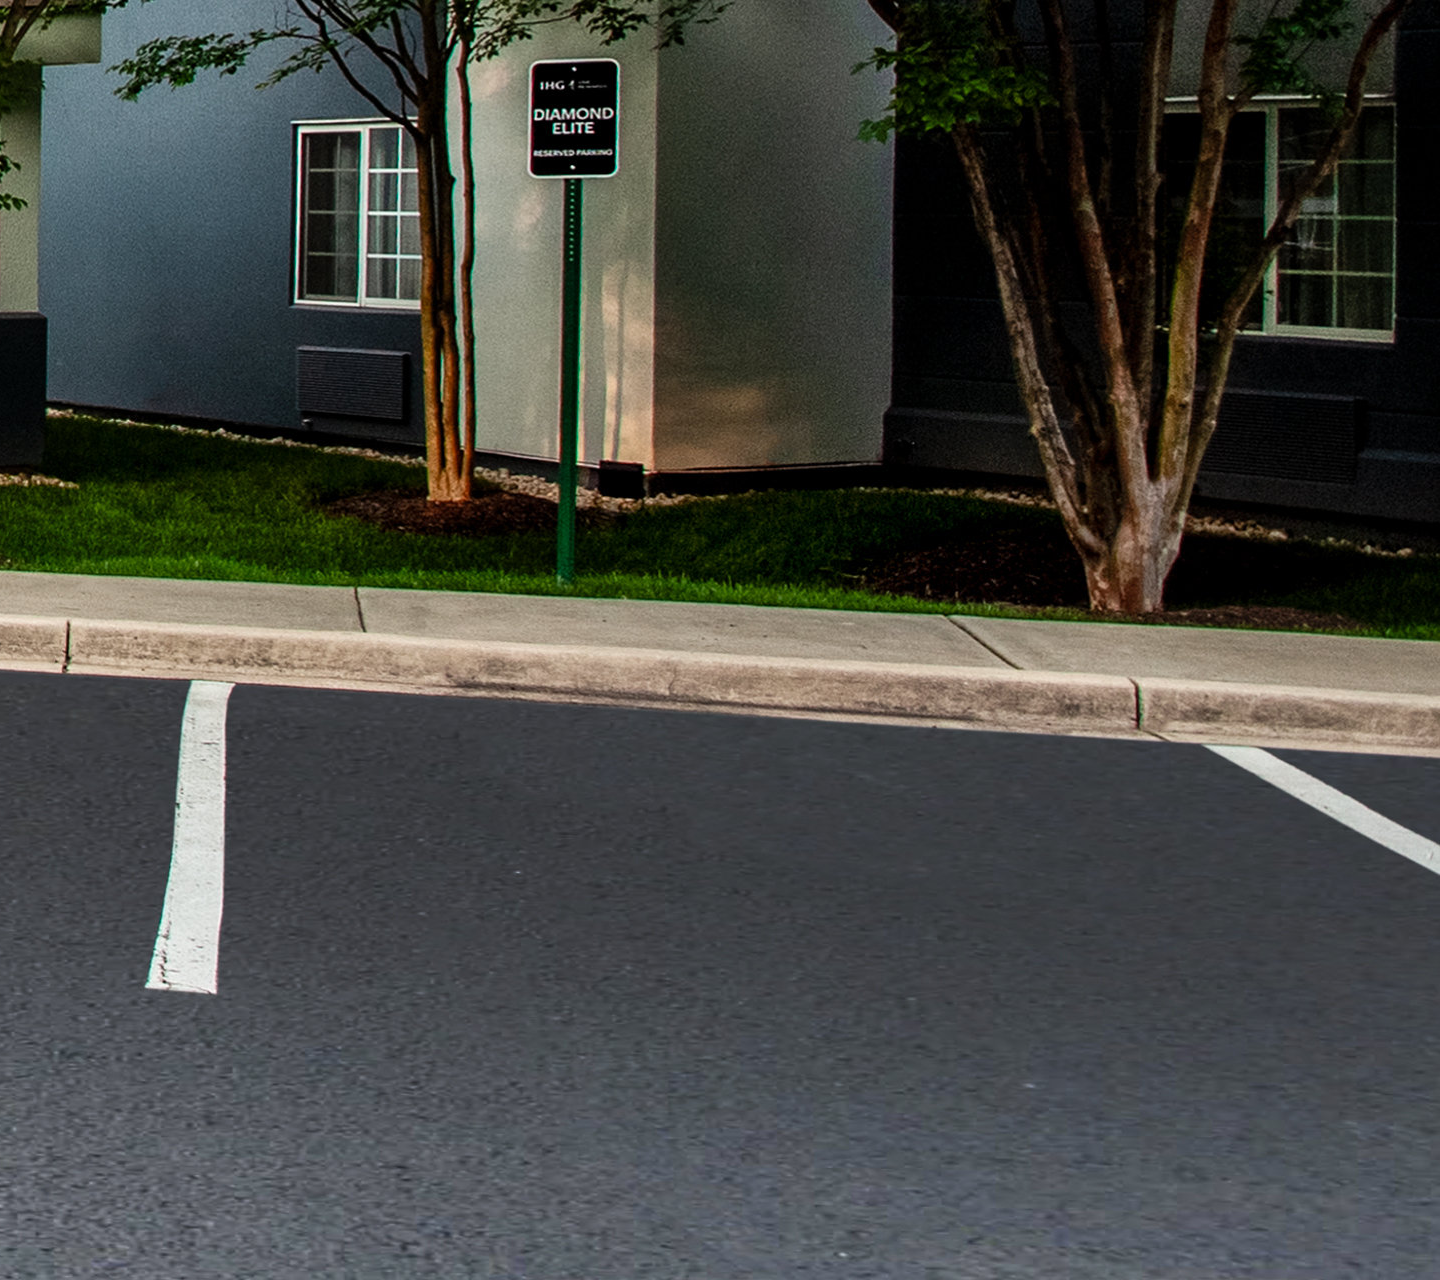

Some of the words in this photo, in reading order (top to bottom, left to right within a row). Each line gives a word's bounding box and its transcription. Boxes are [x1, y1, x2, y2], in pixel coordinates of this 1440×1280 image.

[540, 80, 565, 91] IHG
[533, 107, 615, 122] DIAMOND
[552, 121, 596, 135] ELITE
[533, 149, 575, 157] RESERVED
[576, 148, 613, 156] PARKING
